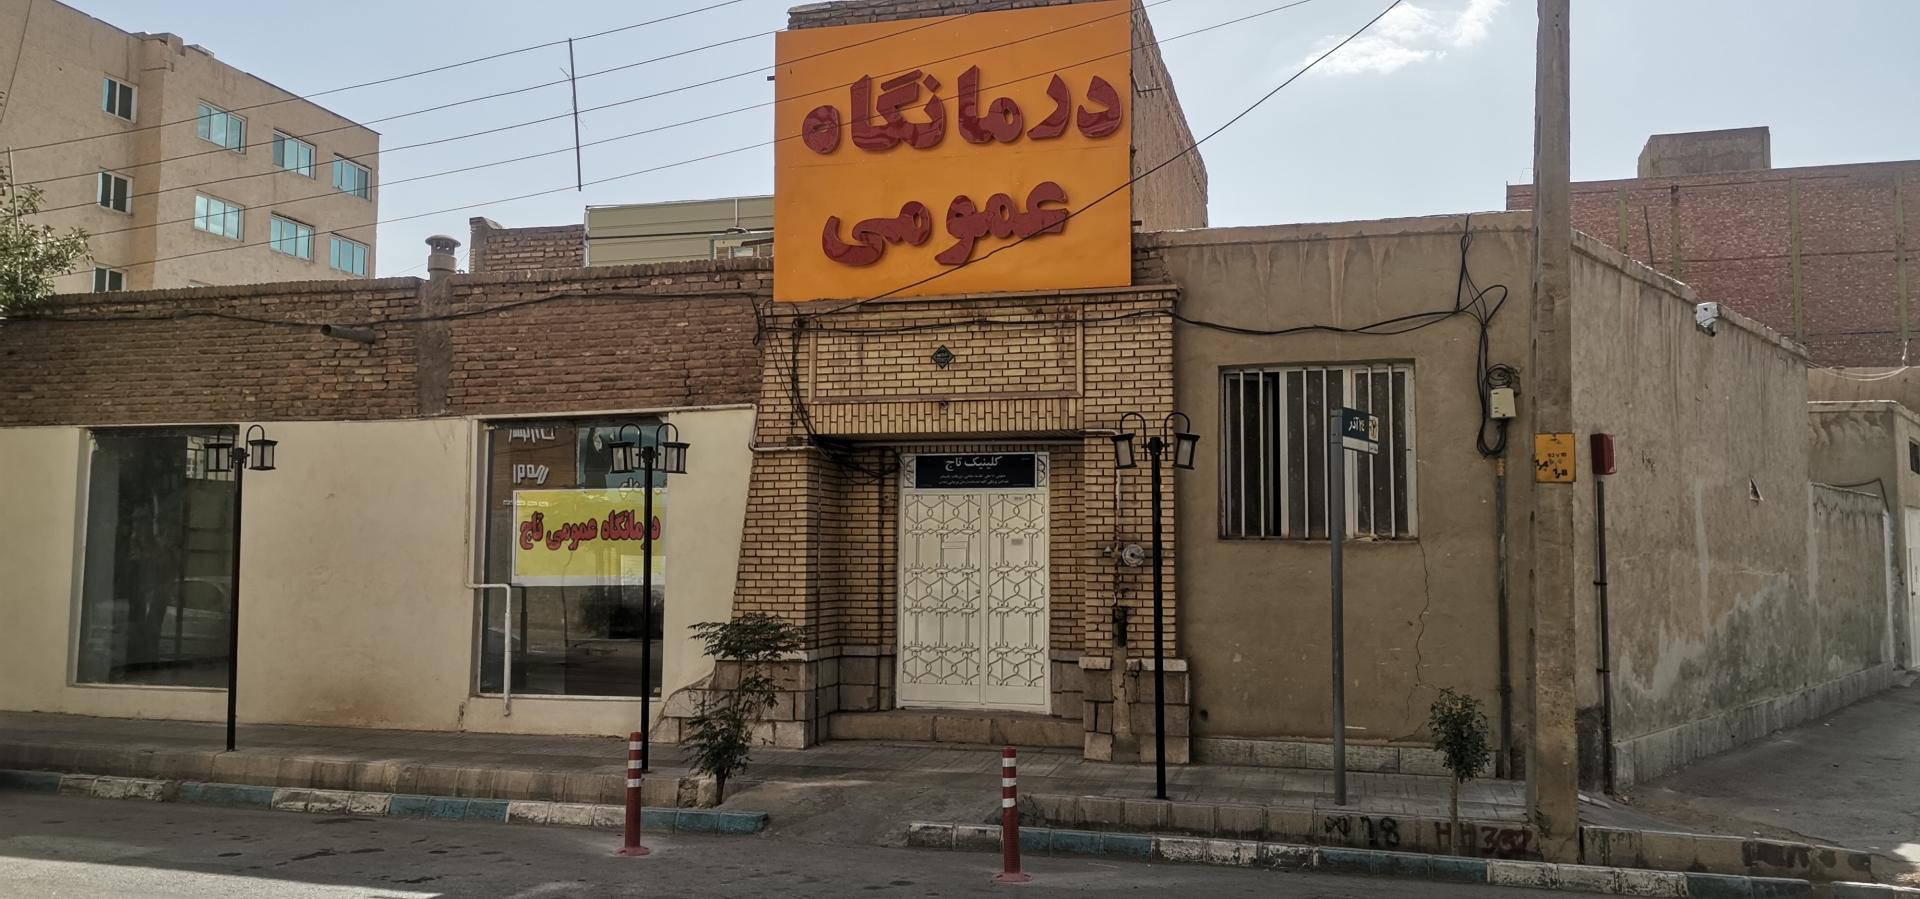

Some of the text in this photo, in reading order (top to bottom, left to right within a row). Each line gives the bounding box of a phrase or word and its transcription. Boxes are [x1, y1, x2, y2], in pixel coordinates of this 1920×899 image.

[802, 65, 1123, 154] درمانگاه
[821, 181, 1069, 267] عمومی
[945, 456, 1003, 471] کلینیک تاج
[519, 509, 661, 550] دمانگاه عمومی تاج
